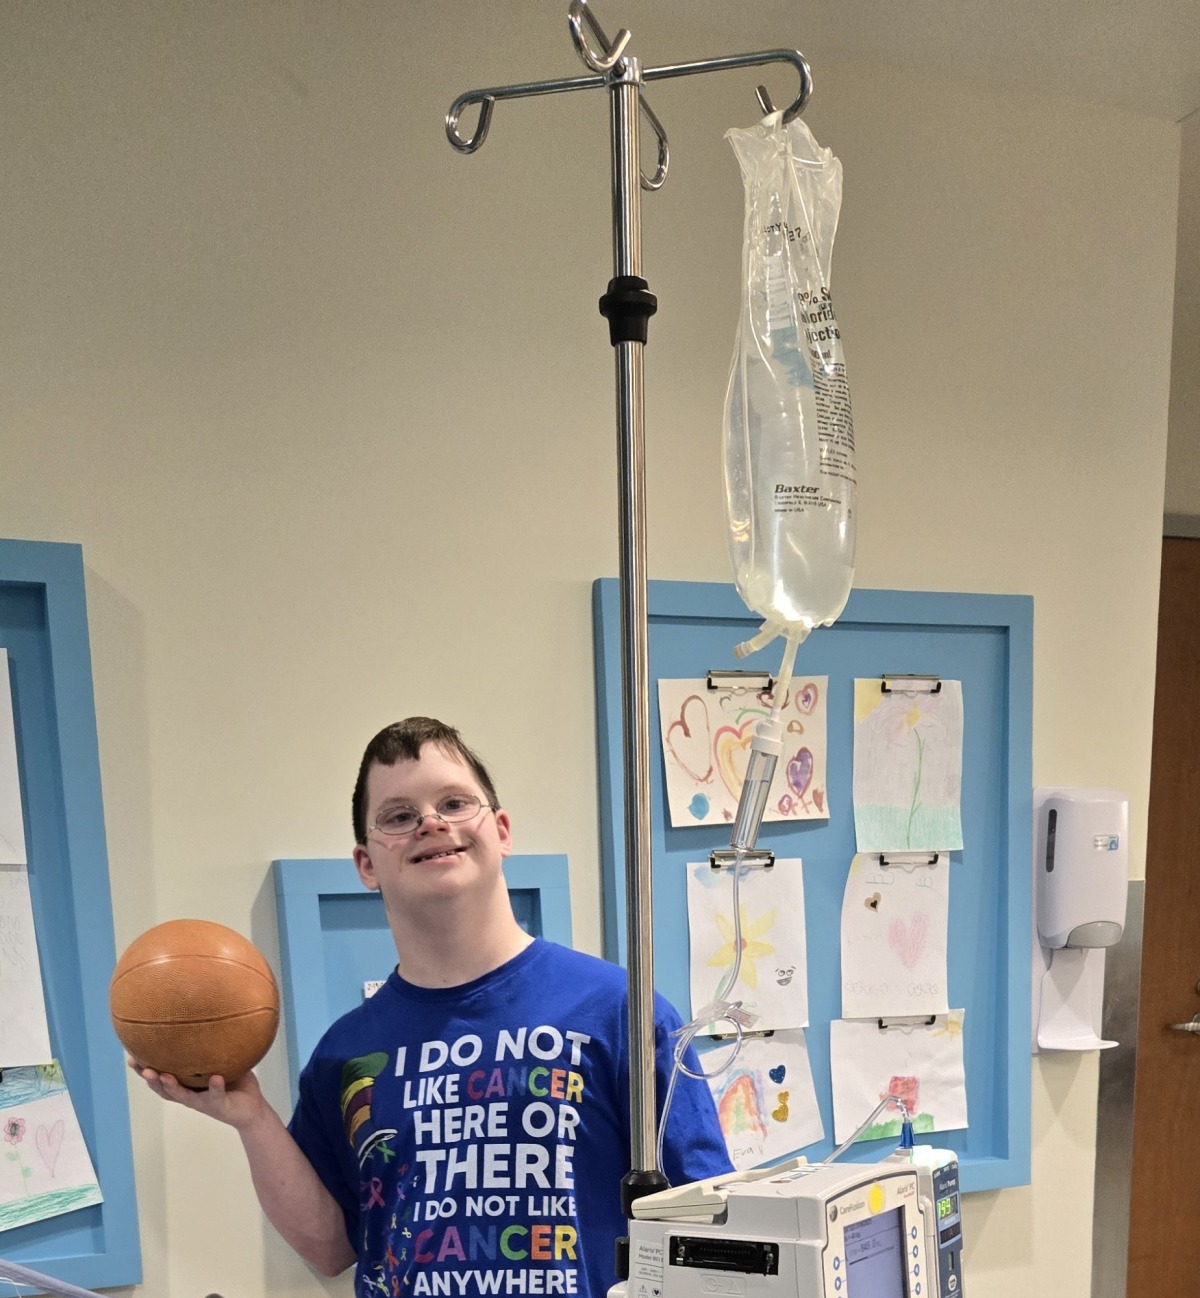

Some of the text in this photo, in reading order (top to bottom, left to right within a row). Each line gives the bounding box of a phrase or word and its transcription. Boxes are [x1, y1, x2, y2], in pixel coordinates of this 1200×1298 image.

[775, 484, 820, 494] Baxter
[394, 1025, 591, 1077] I DO NOT
[403, 1066, 584, 1110] LIKE CANCER
[413, 1102, 580, 1145] HERE OR
[415, 1144, 574, 1194] THERE
[732, 1148, 754, 1161] Eva
[413, 1195, 577, 1222] I DO NOT LIKE
[414, 1225, 578, 1263] CANCER
[413, 1269, 578, 1297] ANYWHERE
